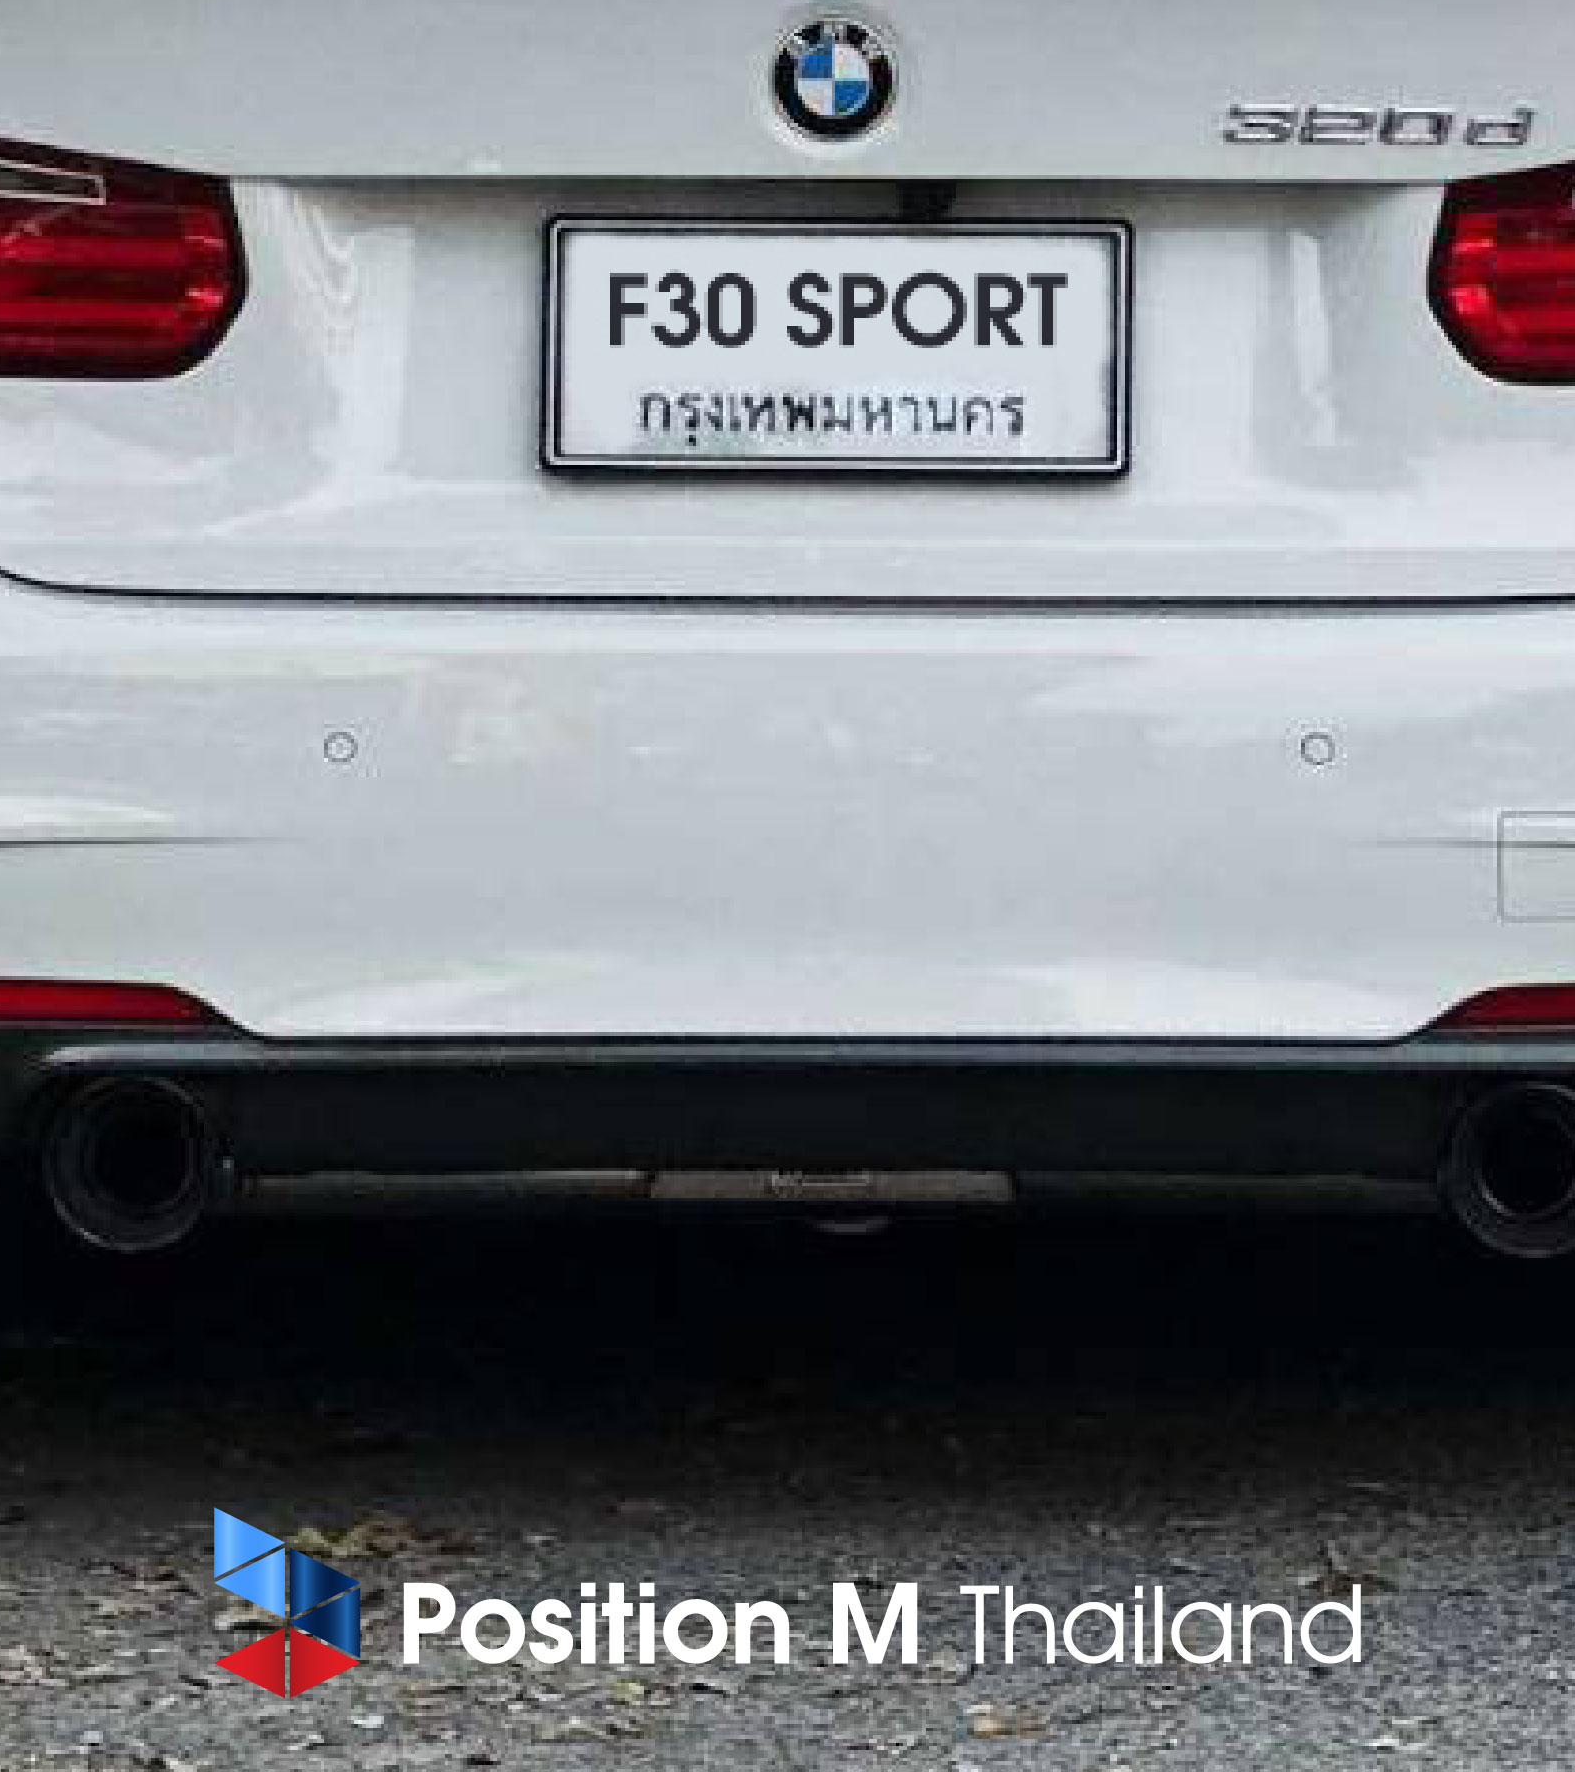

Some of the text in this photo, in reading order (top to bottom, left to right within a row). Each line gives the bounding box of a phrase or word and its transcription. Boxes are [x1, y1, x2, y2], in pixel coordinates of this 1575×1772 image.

[1223, 100, 1535, 147] 320d
[608, 270, 1069, 350] F30 SPORT
[637, 390, 1026, 448] กรุงเทพมหานคร
